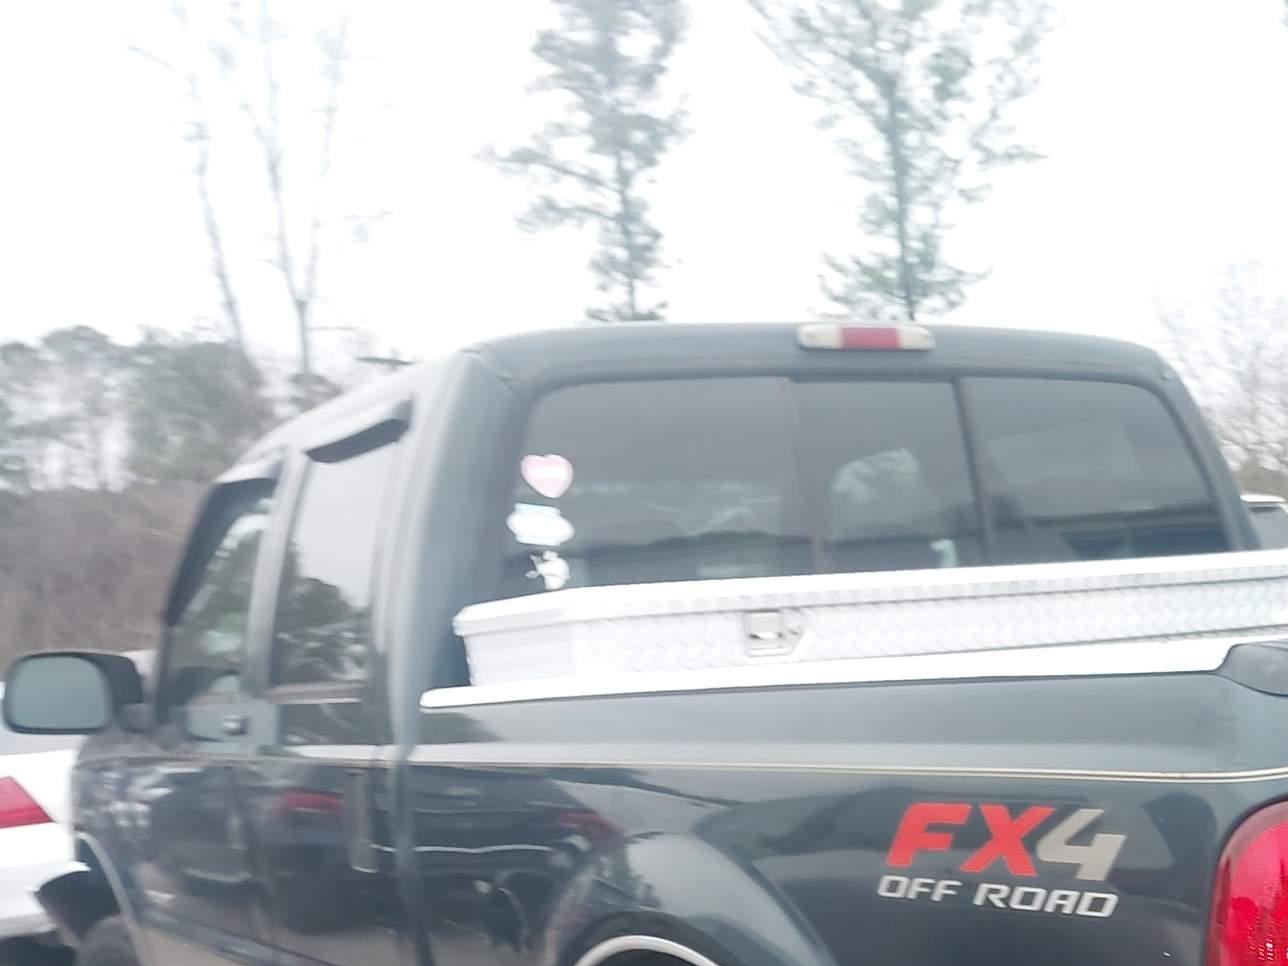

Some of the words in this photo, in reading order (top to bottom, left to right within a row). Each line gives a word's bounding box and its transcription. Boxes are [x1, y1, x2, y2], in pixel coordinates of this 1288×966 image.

[886, 802, 1127, 881] FX4
[877, 875, 963, 902] OFF
[972, 883, 1119, 918] ROAD
